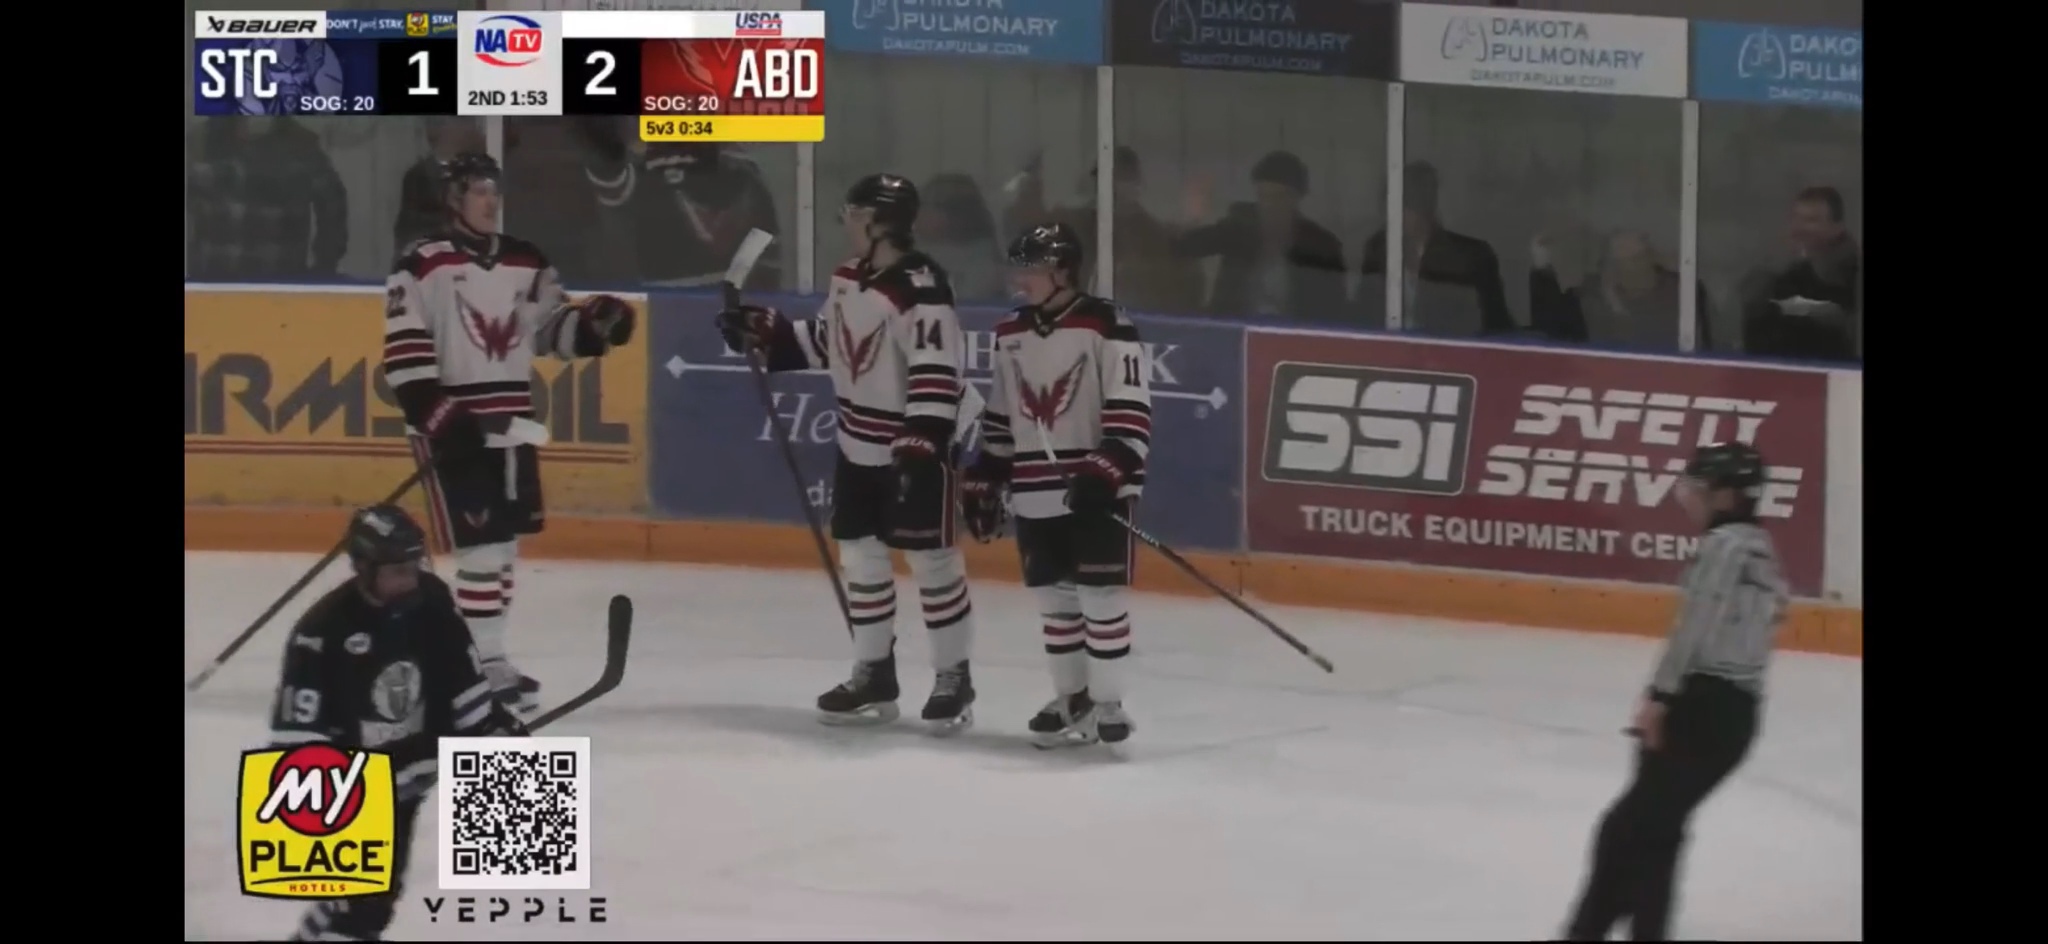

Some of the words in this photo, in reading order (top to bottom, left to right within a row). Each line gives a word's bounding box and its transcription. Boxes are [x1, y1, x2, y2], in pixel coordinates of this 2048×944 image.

[903, 12, 1058, 36] PULMONARY
[1200, 0, 1297, 23] DAKOTA
[1201, 26, 1352, 52] PULMONARY
[1492, 17, 1589, 40] DAKOTA
[1491, 43, 1645, 70] PULMONARY
[1789, 33, 1861, 57] DAKO
[1789, 60, 1861, 82] PULM
[914, 318, 943, 351] 14
[1123, 354, 1142, 388] 11
[1278, 375, 1460, 482] SSI
[1512, 384, 1778, 447] SAFETY
[1479, 443, 1804, 519] SERVE
[1299, 505, 1413, 539] TRUCK
[1424, 515, 1621, 556] EQUIPMENT
[1630, 532, 1699, 561] CEN
[282, 685, 321, 724] 19
